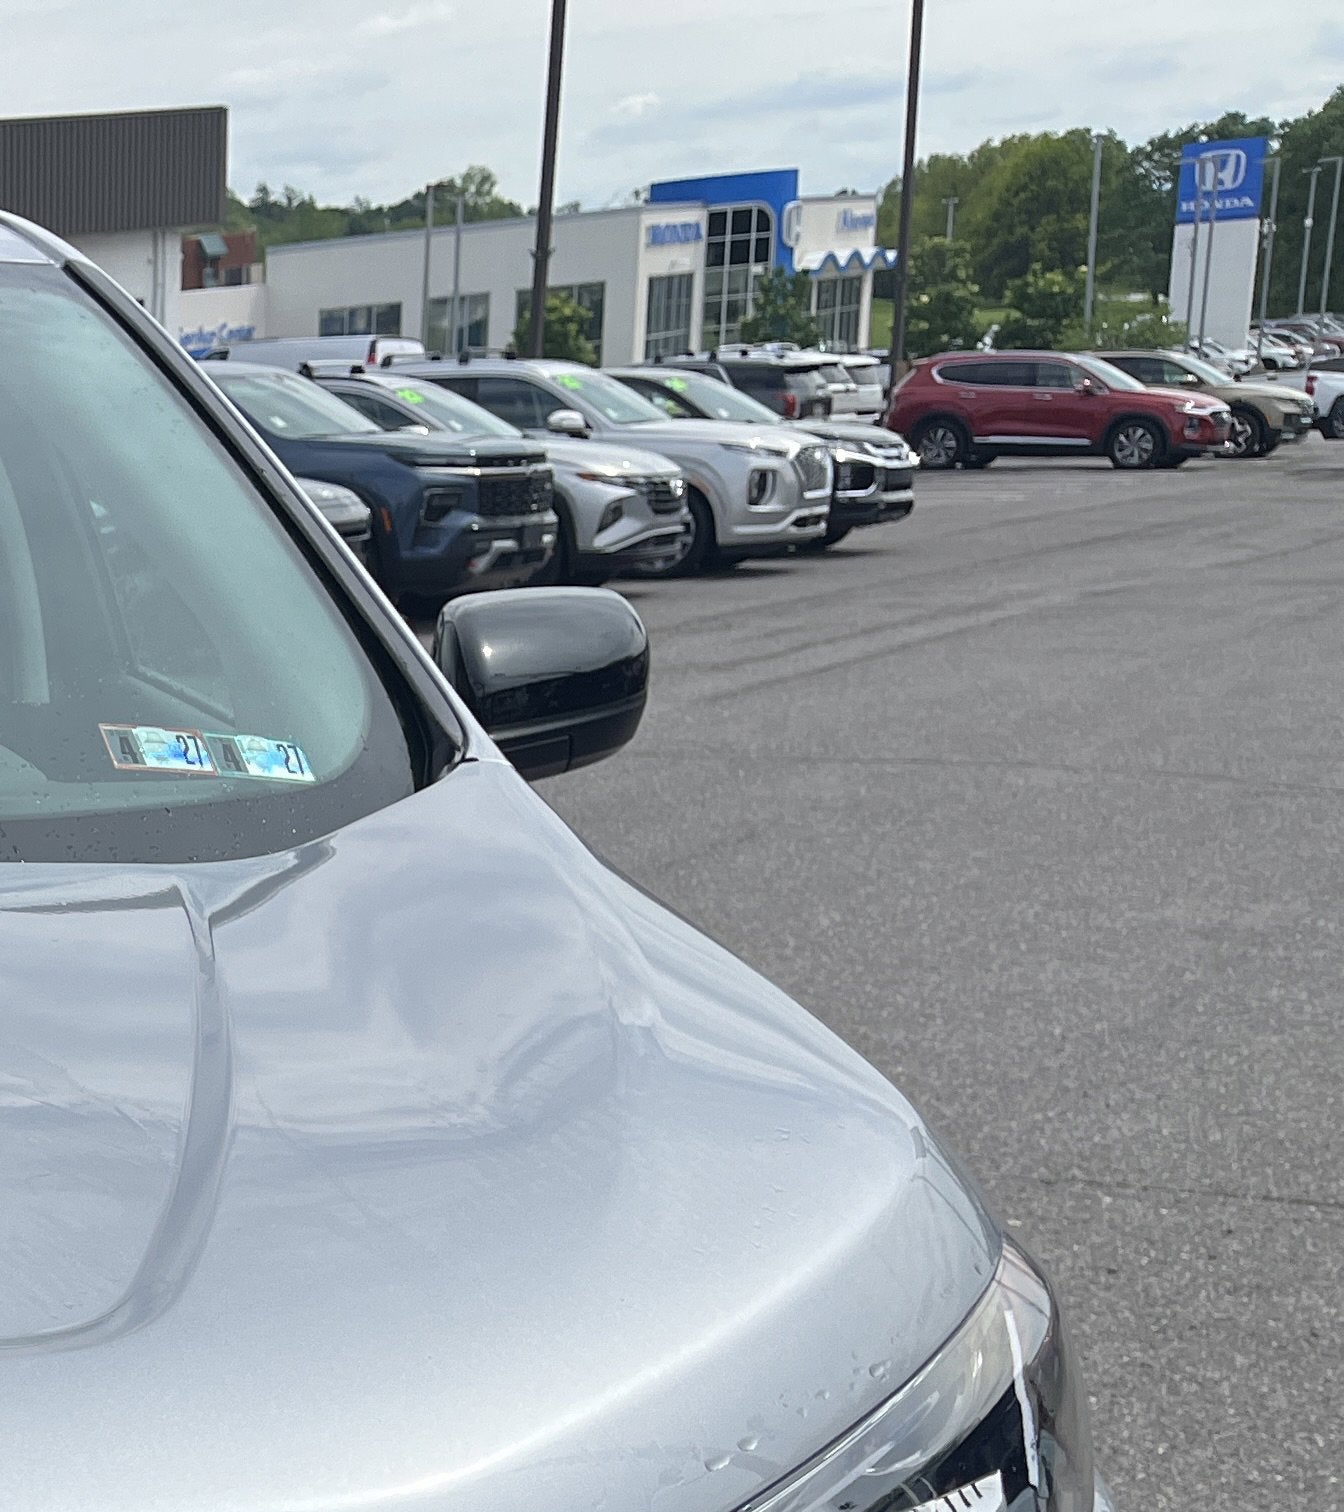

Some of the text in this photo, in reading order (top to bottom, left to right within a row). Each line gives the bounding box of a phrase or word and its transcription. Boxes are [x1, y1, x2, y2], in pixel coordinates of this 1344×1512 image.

[1180, 196, 1254, 213] HONDA
[176, 735, 204, 768] 27
[276, 743, 305, 774] 27
